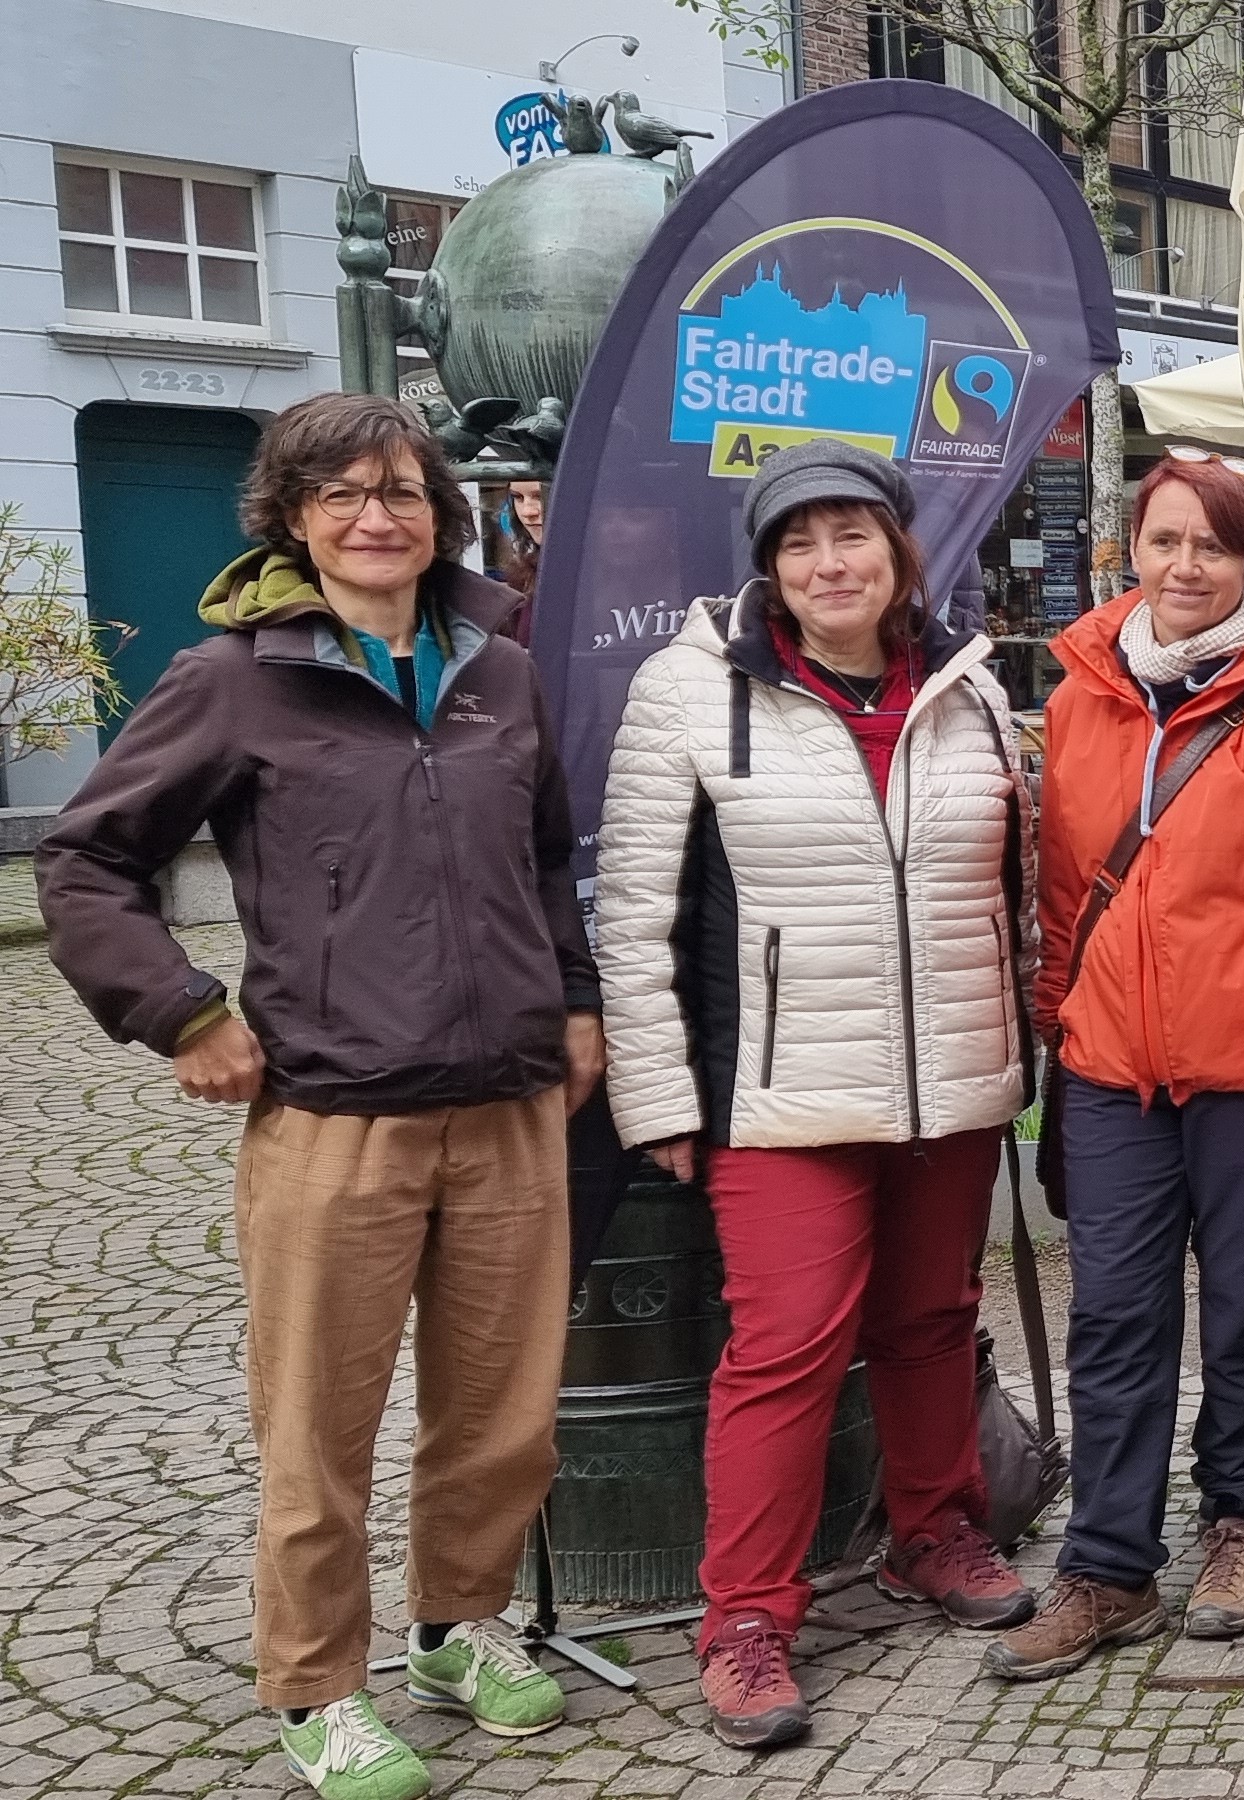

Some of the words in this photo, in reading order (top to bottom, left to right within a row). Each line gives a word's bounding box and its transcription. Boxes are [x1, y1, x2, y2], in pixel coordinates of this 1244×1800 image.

[510, 125, 568, 169] FAS
[387, 225, 427, 245] eine
[686, 327, 912, 384] Fairtrade-
[399, 380, 440, 401] köre
[681, 370, 807, 416] Stadt
[920, 440, 1001, 458] FAIRTRADE
